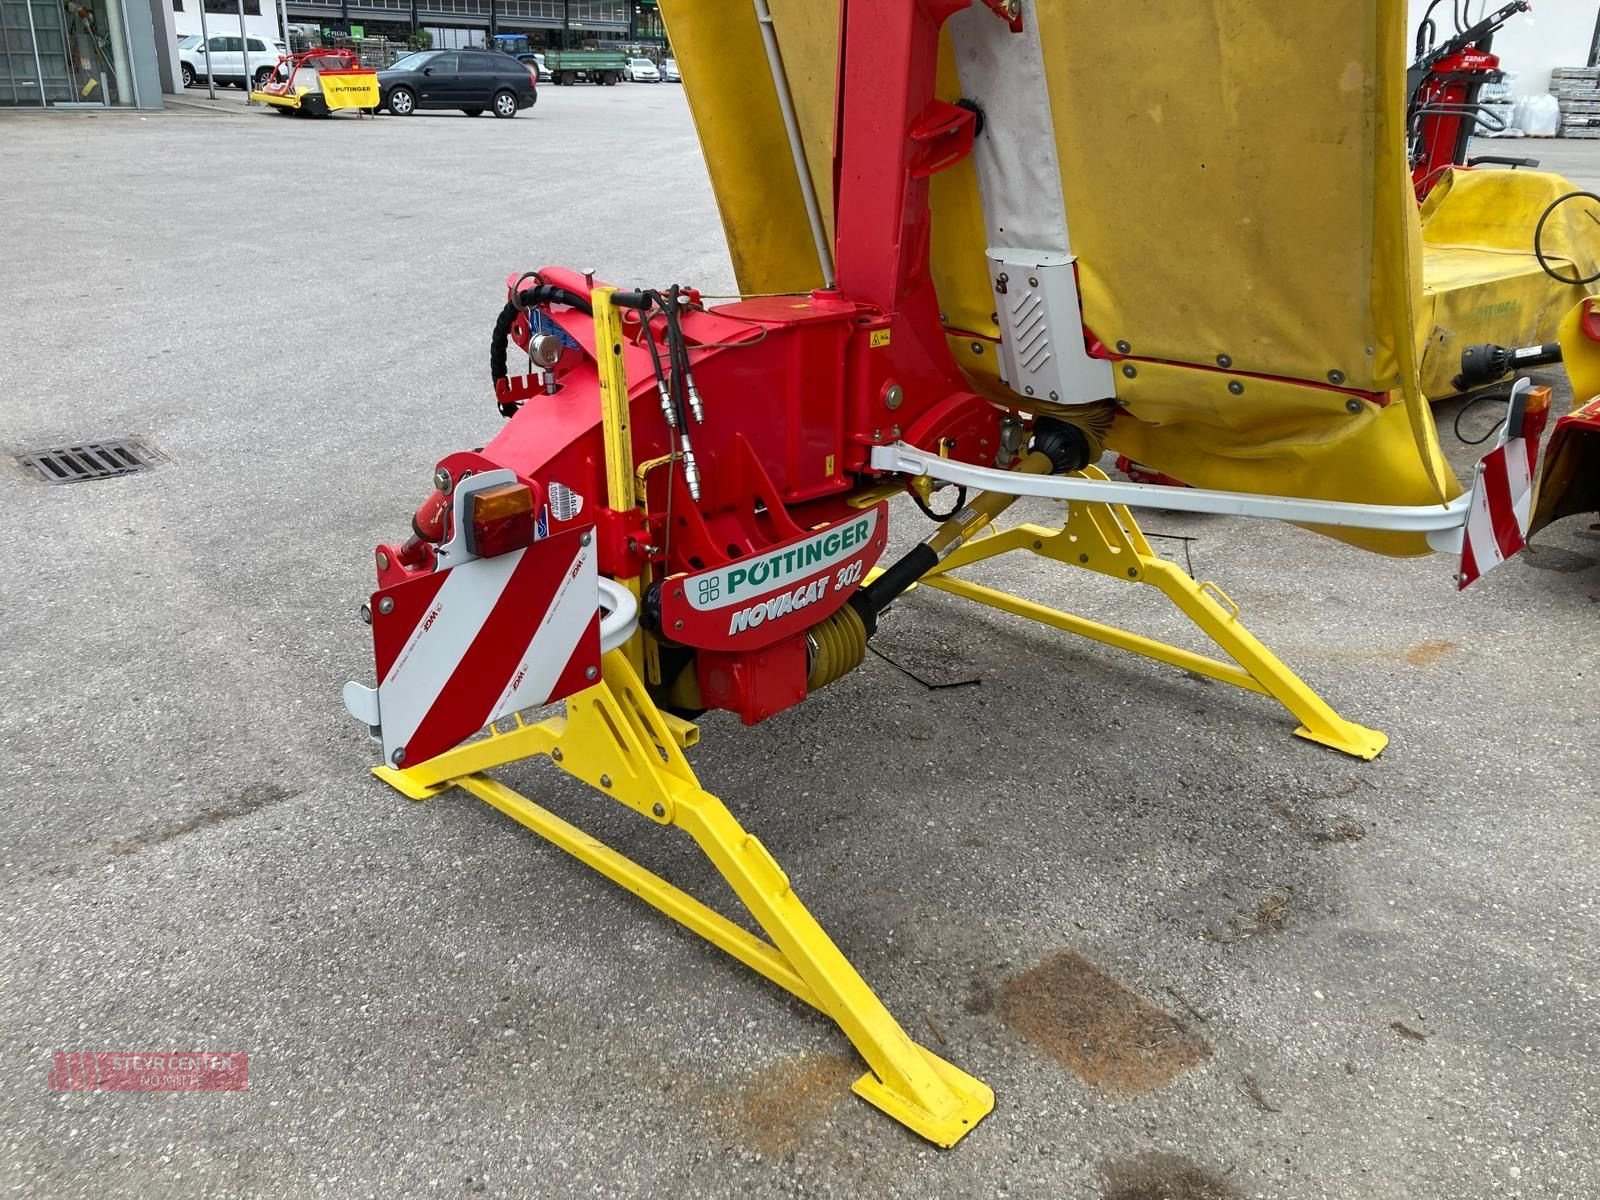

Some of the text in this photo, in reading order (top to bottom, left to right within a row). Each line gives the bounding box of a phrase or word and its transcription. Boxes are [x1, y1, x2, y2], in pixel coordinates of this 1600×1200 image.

[728, 519, 869, 595] PÖTTINGER
[423, 610, 439, 633] WGF
[728, 559, 863, 636] NOVACAT 302
